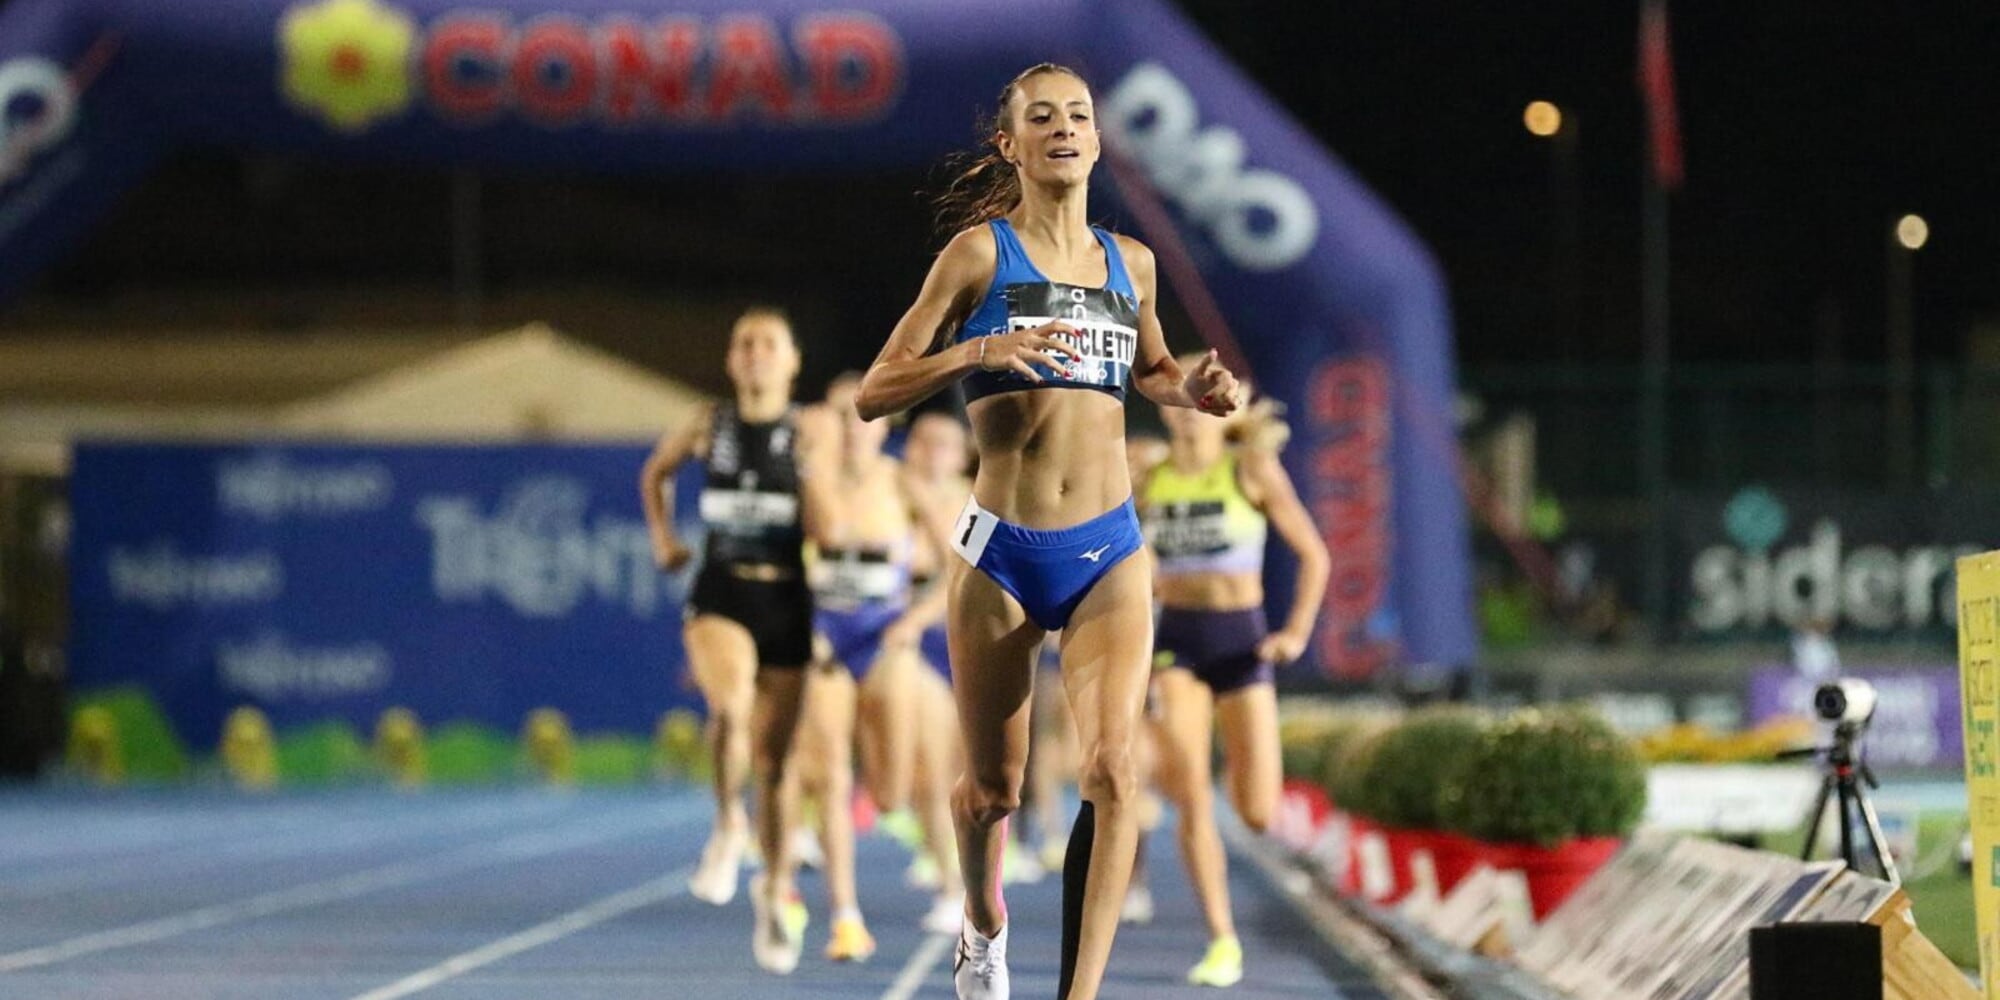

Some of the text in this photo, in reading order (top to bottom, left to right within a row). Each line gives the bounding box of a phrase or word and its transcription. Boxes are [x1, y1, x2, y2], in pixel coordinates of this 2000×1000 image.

[422, 14, 905, 124] CONAD
[1014, 324, 1134, 363] CLETTI
[961, 514, 978, 547] 1
[1308, 360, 1395, 680] CONAD
